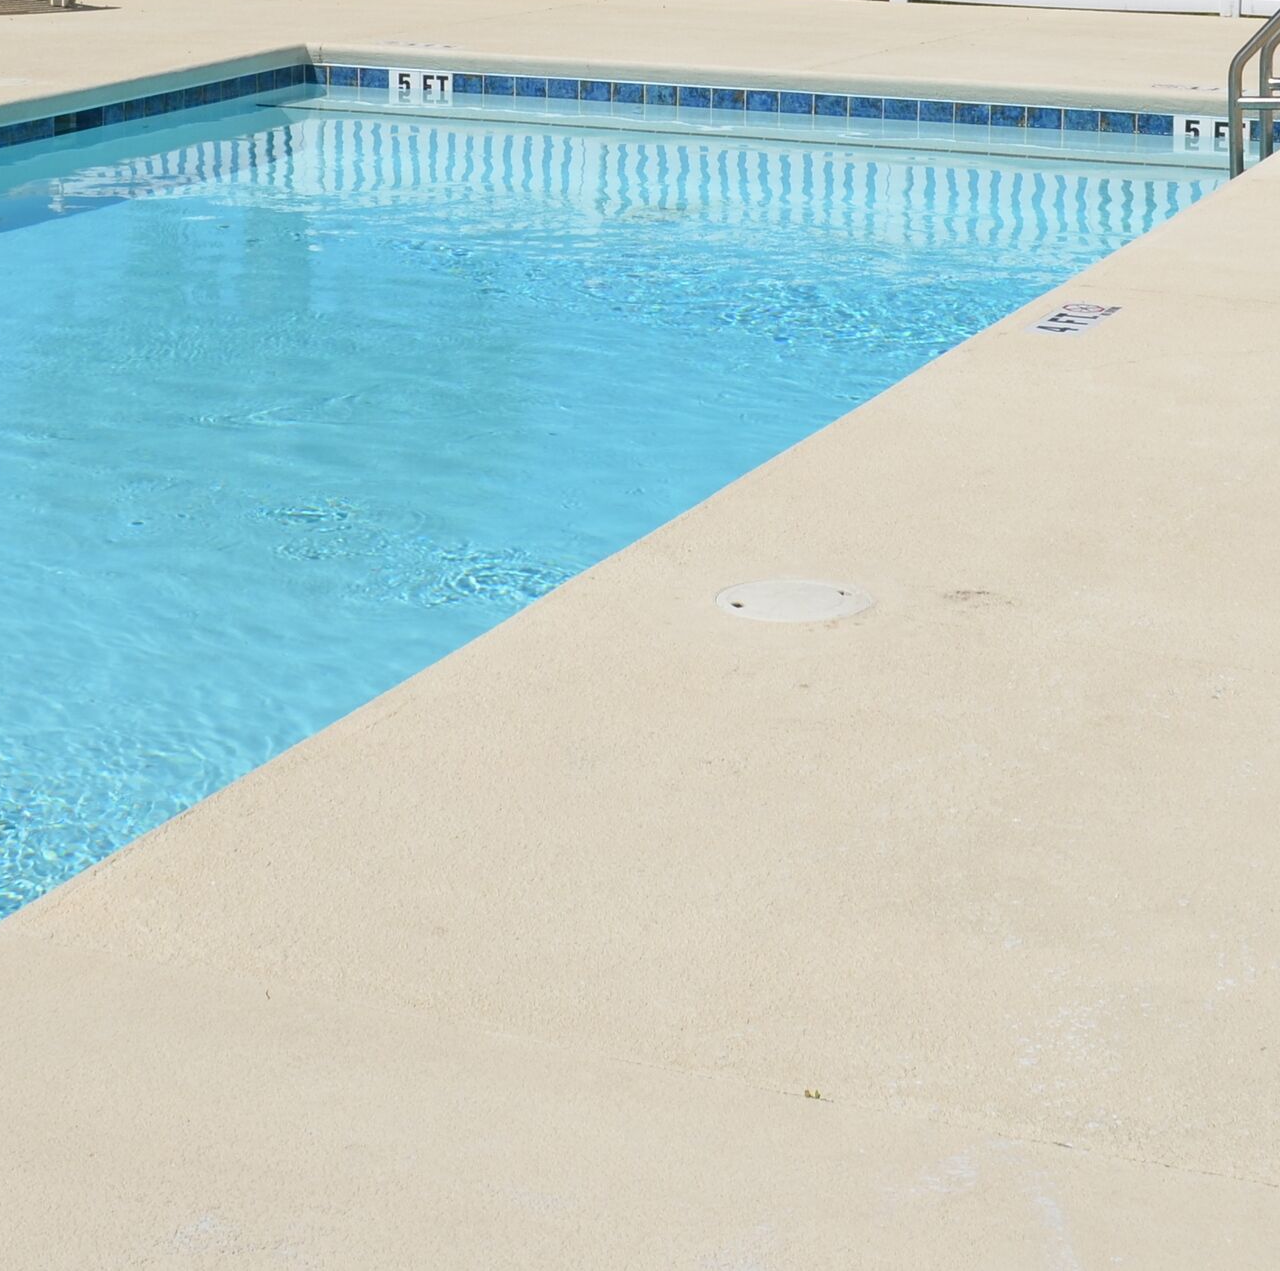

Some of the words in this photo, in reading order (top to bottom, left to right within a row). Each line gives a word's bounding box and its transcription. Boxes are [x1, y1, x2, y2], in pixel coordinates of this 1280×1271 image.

[398, 73, 411, 90] 5
[422, 75, 449, 92] FT
[1185, 119, 1200, 138] 5
